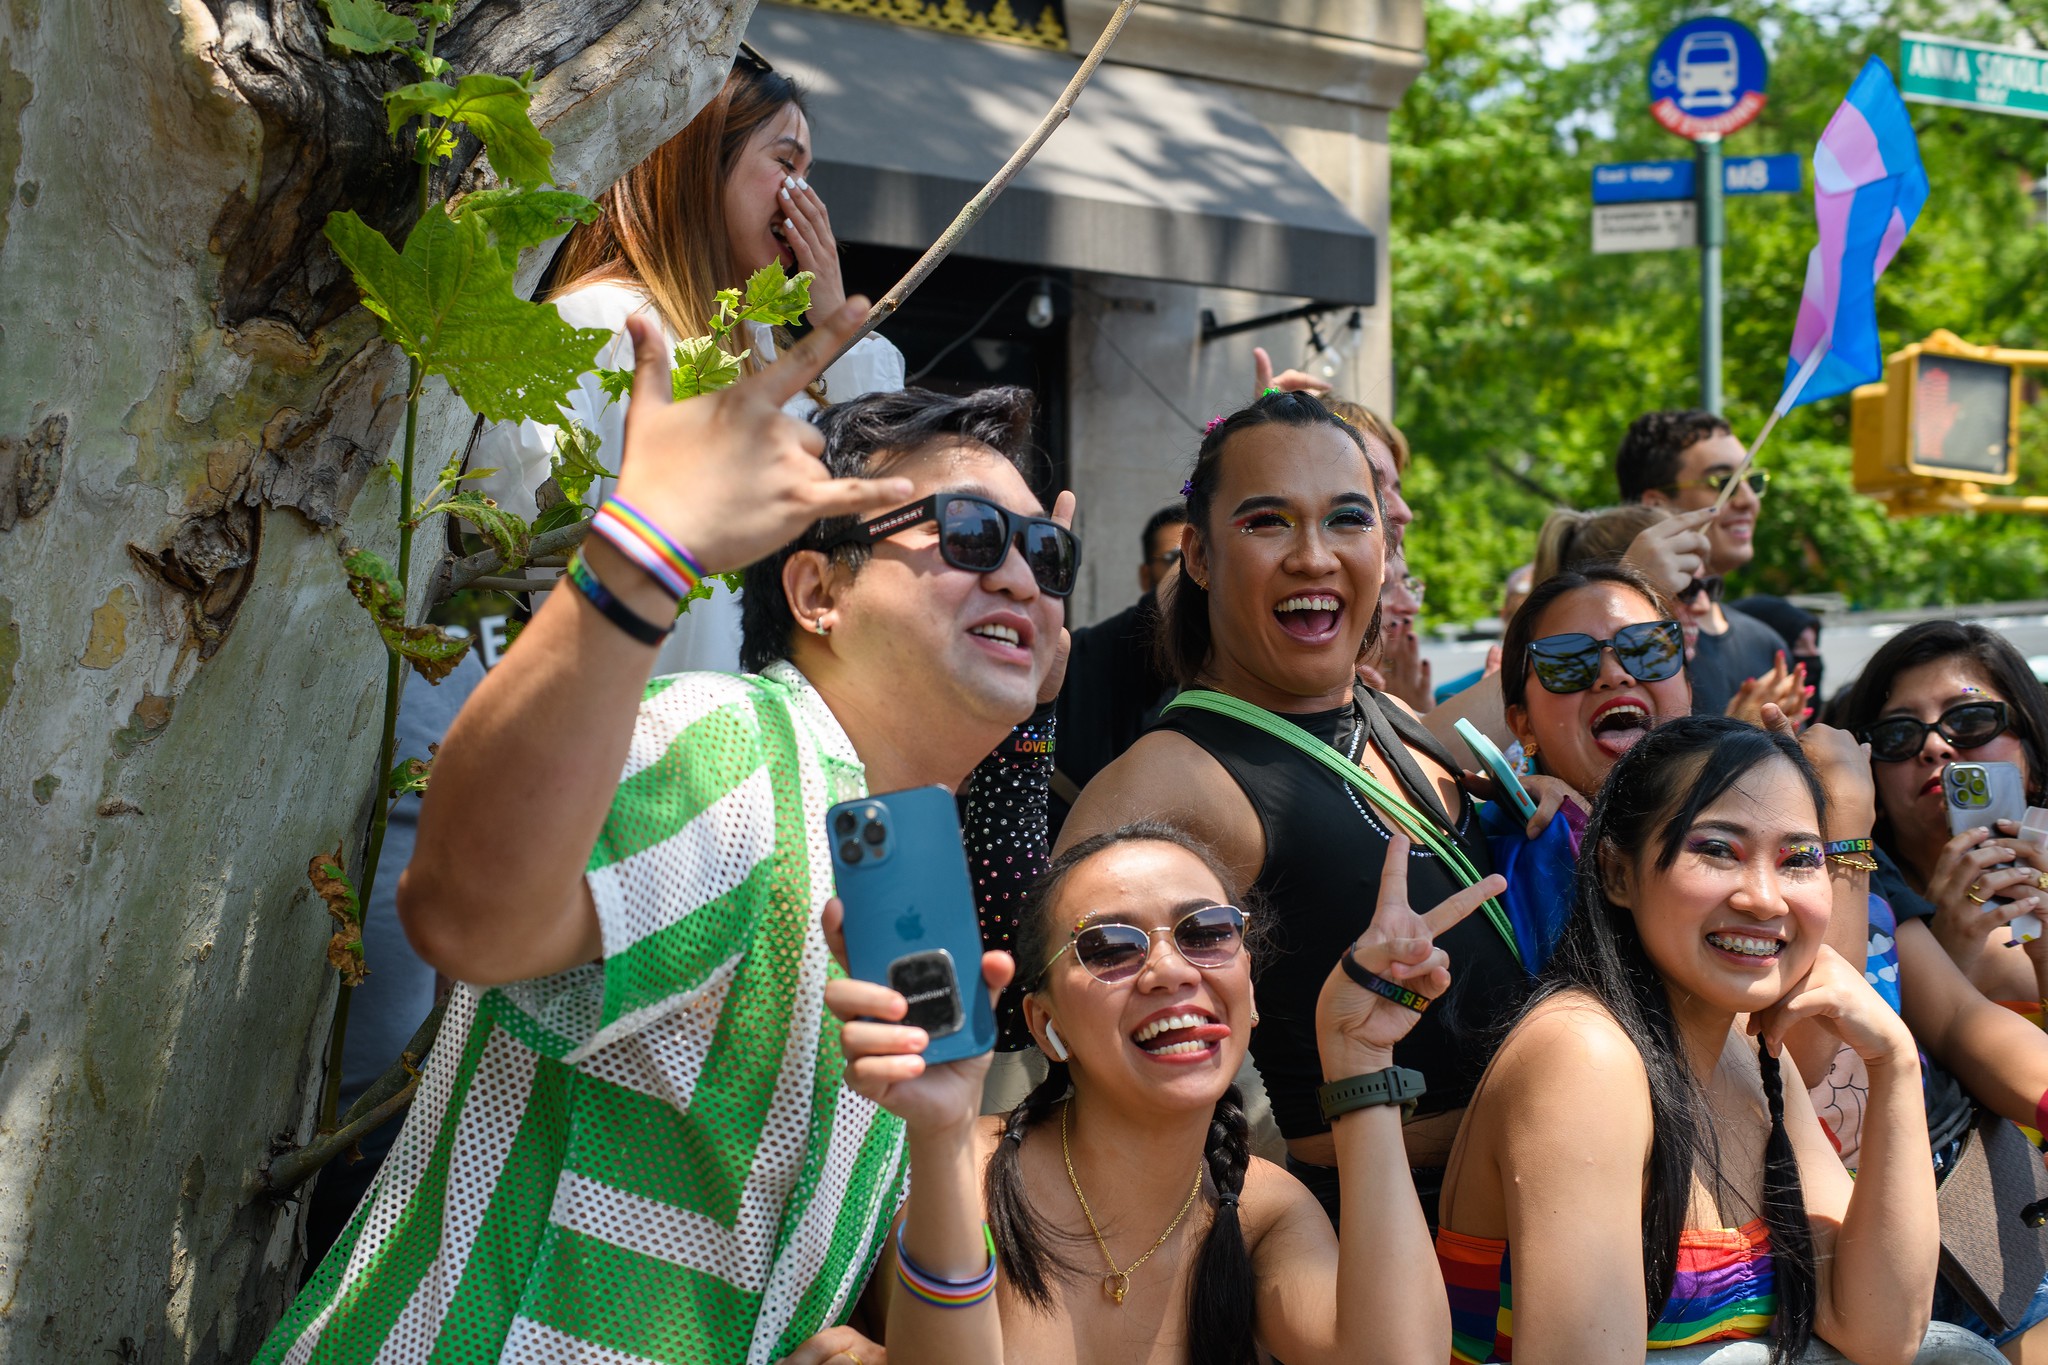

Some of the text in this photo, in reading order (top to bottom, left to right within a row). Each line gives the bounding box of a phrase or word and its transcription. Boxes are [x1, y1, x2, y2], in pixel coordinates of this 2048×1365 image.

[1908, 43, 1971, 84] ANNA
[1596, 166, 1673, 184] East Village
[1726, 160, 1768, 190] M8
[869, 506, 925, 536] BURBERRY
[1015, 740, 1046, 753] LOVE
[1856, 840, 1866, 851] IS
[1366, 977, 1402, 1002] LOVE
[1402, 991, 1415, 1006] IS
